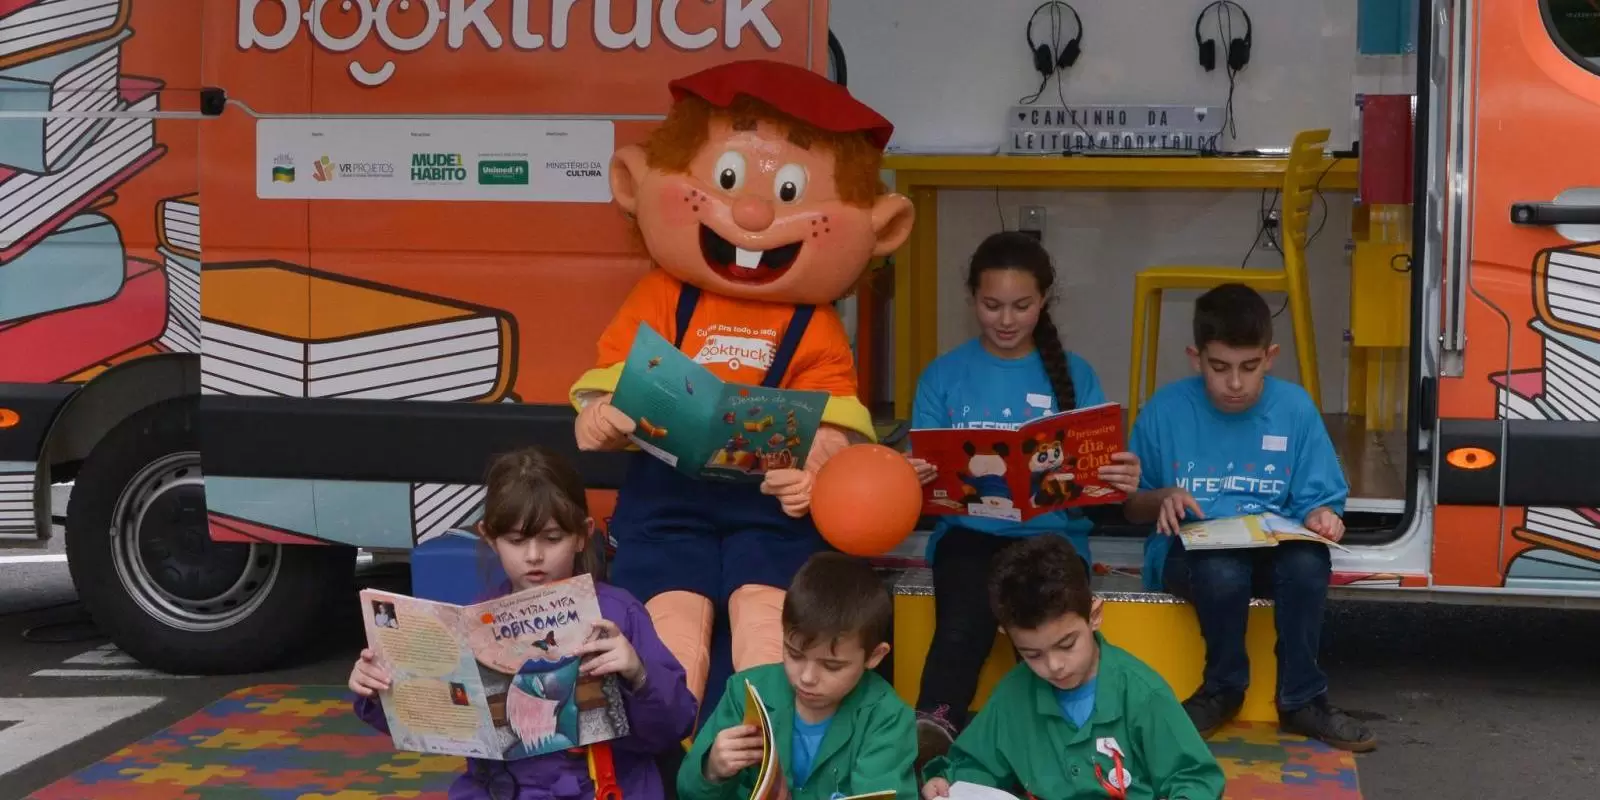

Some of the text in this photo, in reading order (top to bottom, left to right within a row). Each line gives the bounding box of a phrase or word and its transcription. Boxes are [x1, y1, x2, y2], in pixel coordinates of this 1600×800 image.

[237, 0, 782, 50] booktruck
[1031, 109, 1168, 126] CANTINHO DA
[566, 169, 602, 177] CULTURA
[733, 326, 751, 335] todo
[700, 343, 768, 363] ooktruck
[1077, 439, 1104, 455] dia
[491, 609, 580, 641] LOBISOMEM
